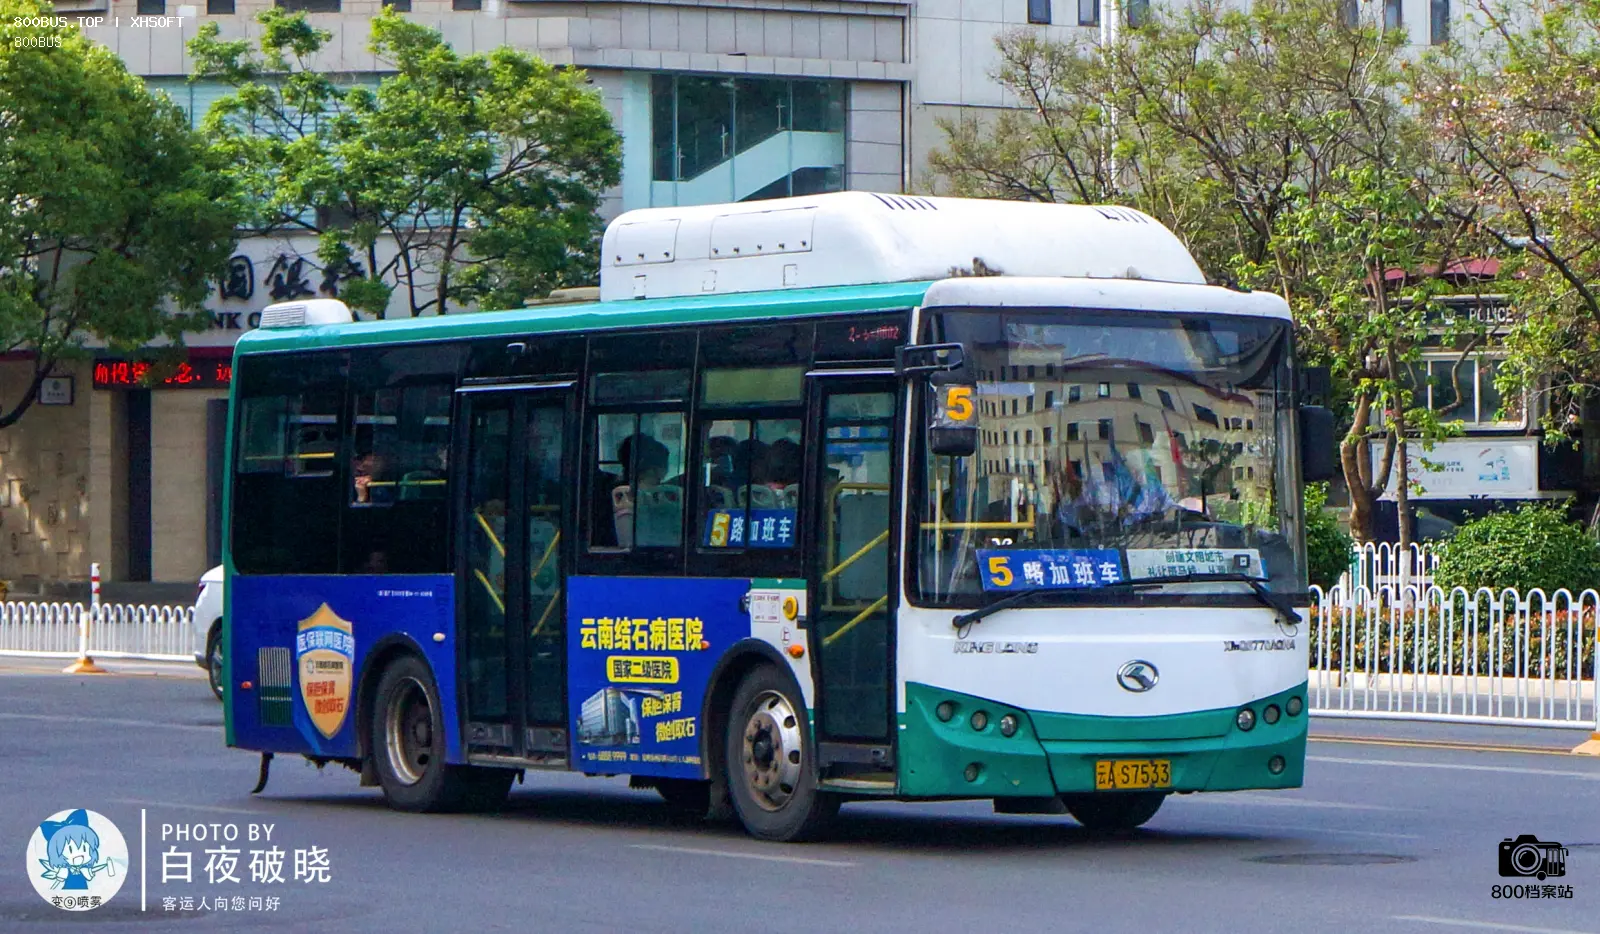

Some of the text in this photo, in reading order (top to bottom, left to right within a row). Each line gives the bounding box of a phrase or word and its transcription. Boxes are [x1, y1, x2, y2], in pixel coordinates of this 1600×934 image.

[1469, 307, 1514, 323] POLICE
[946, 387, 974, 421] 5
[710, 513, 729, 547] 5
[1165, 551, 1225, 563] 创建文明城市
[988, 556, 1120, 587] 5 路加班车
[296, 630, 355, 654] 医保联网医院
[580, 617, 704, 651] 云南结石病医院
[953, 641, 1039, 654] KING LONG
[613, 659, 672, 680] 国家二级医院
[641, 691, 683, 718] 保胆保肾
[655, 717, 697, 743] 微创取石
